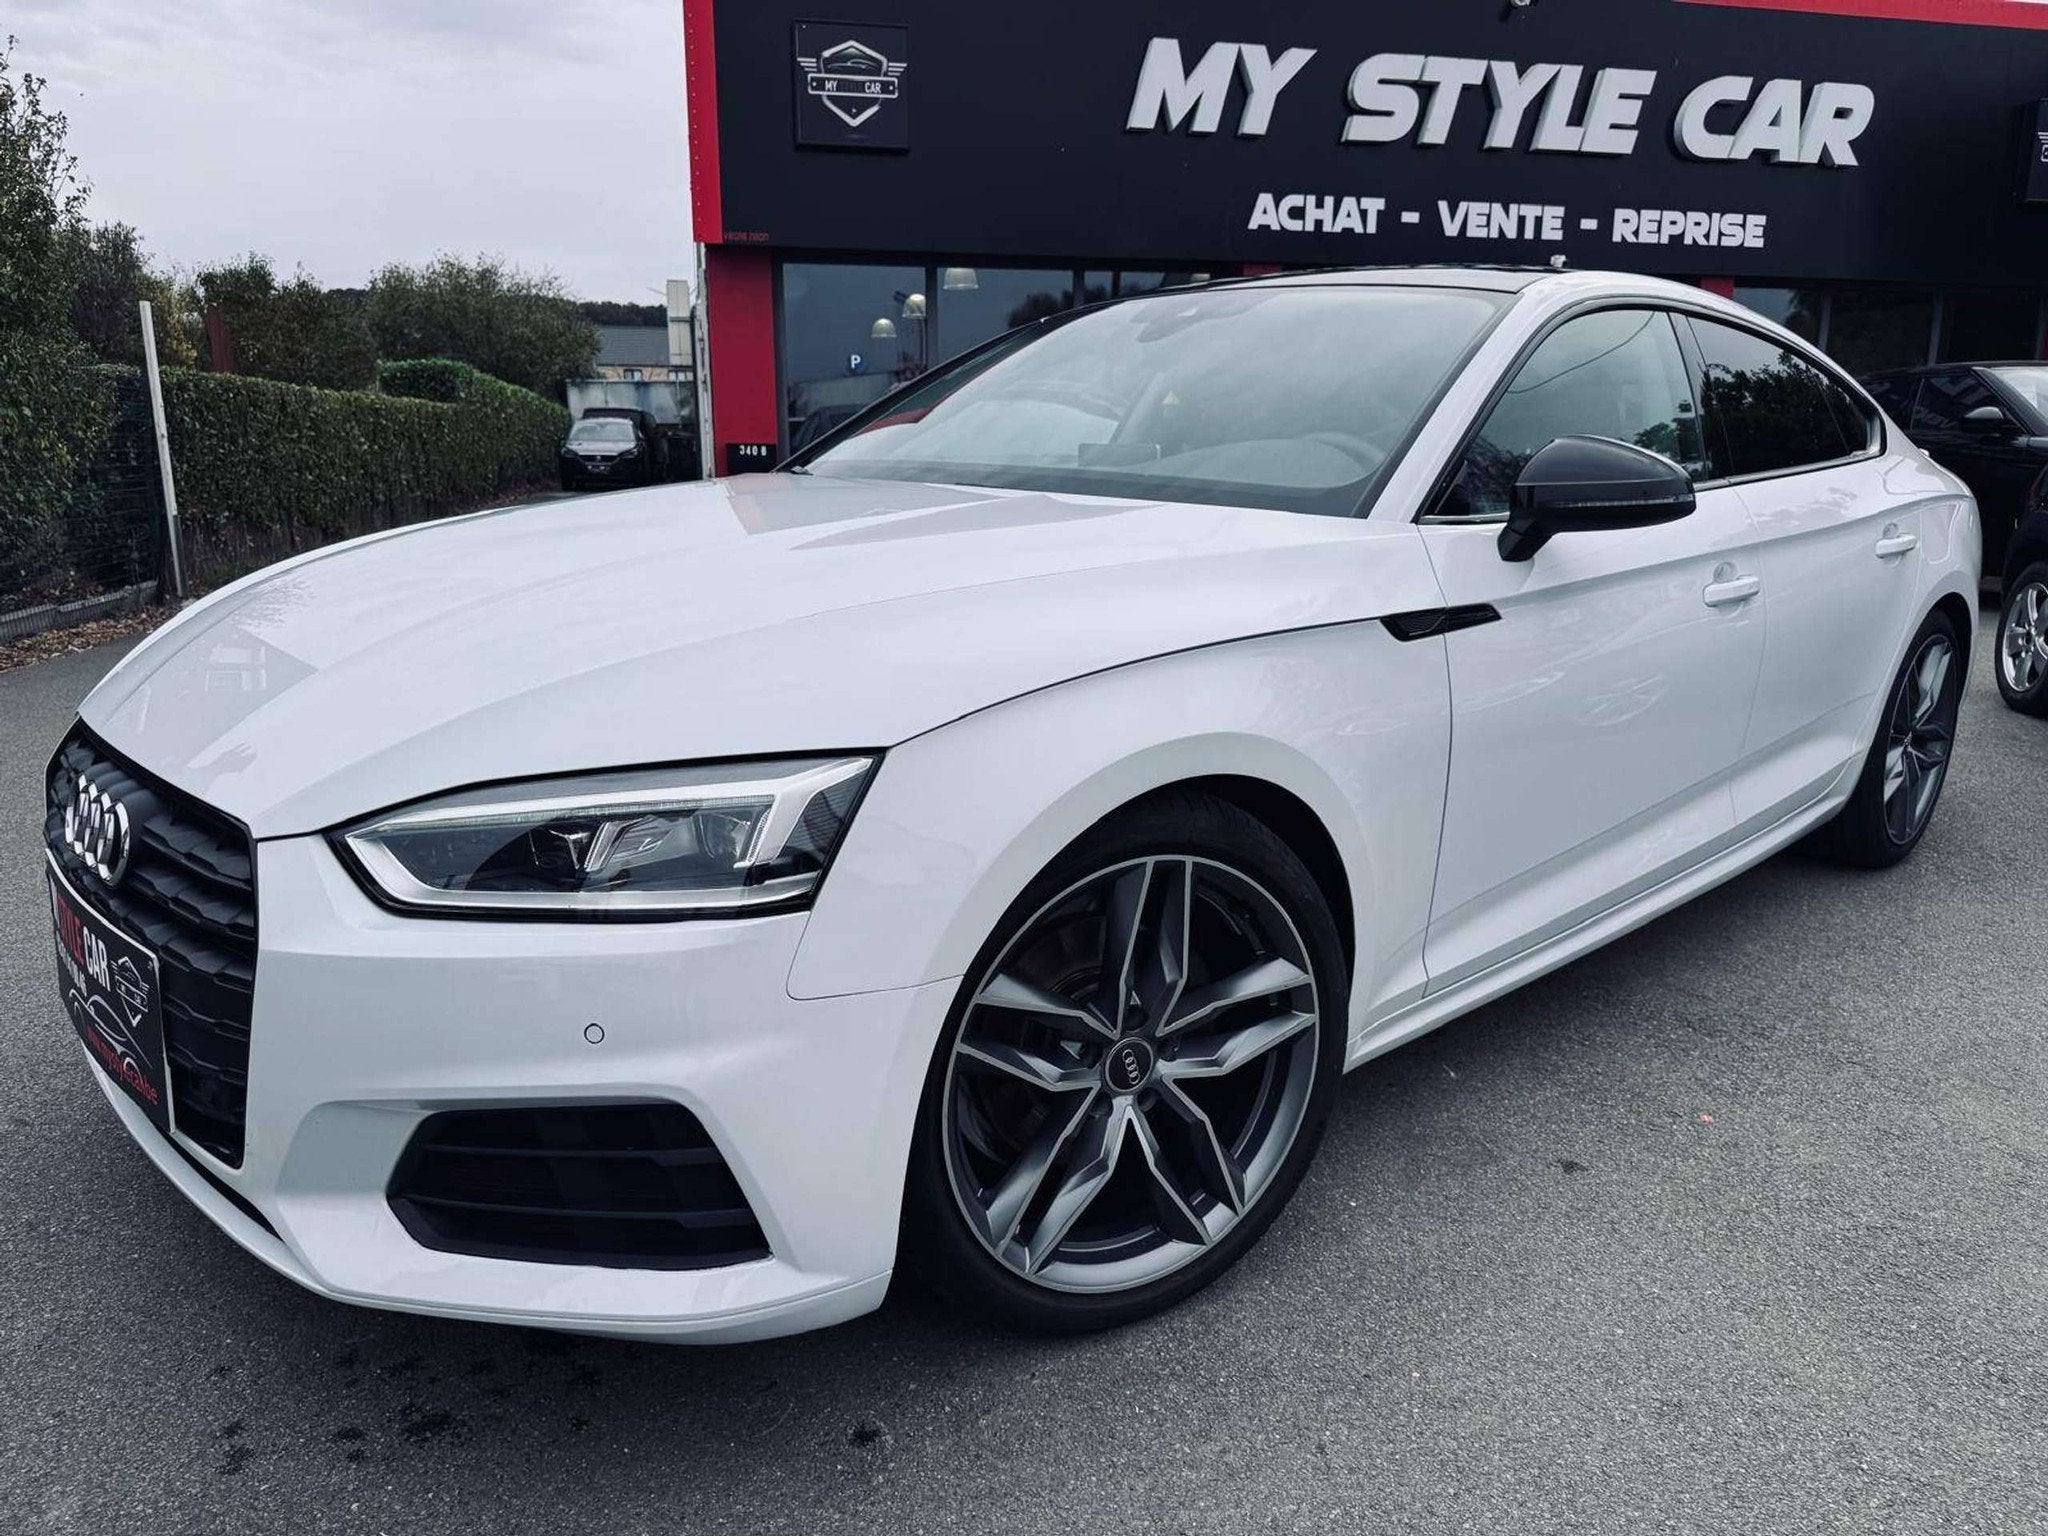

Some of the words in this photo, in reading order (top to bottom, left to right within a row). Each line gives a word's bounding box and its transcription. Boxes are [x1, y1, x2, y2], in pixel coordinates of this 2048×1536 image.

[825, 79, 838, 91] MY
[864, 82, 881, 94] CAR
[1126, 37, 1317, 136] MY
[1340, 53, 1657, 155] STYLE
[1674, 75, 1875, 166] CAR
[1247, 192, 1386, 234] ACHAT
[1437, 200, 1566, 241] VENTE
[1612, 208, 1767, 248] REPRISE
[850, 354, 861, 369] P
[739, 444, 758, 456] 340
[83, 925, 111, 992] CAR
